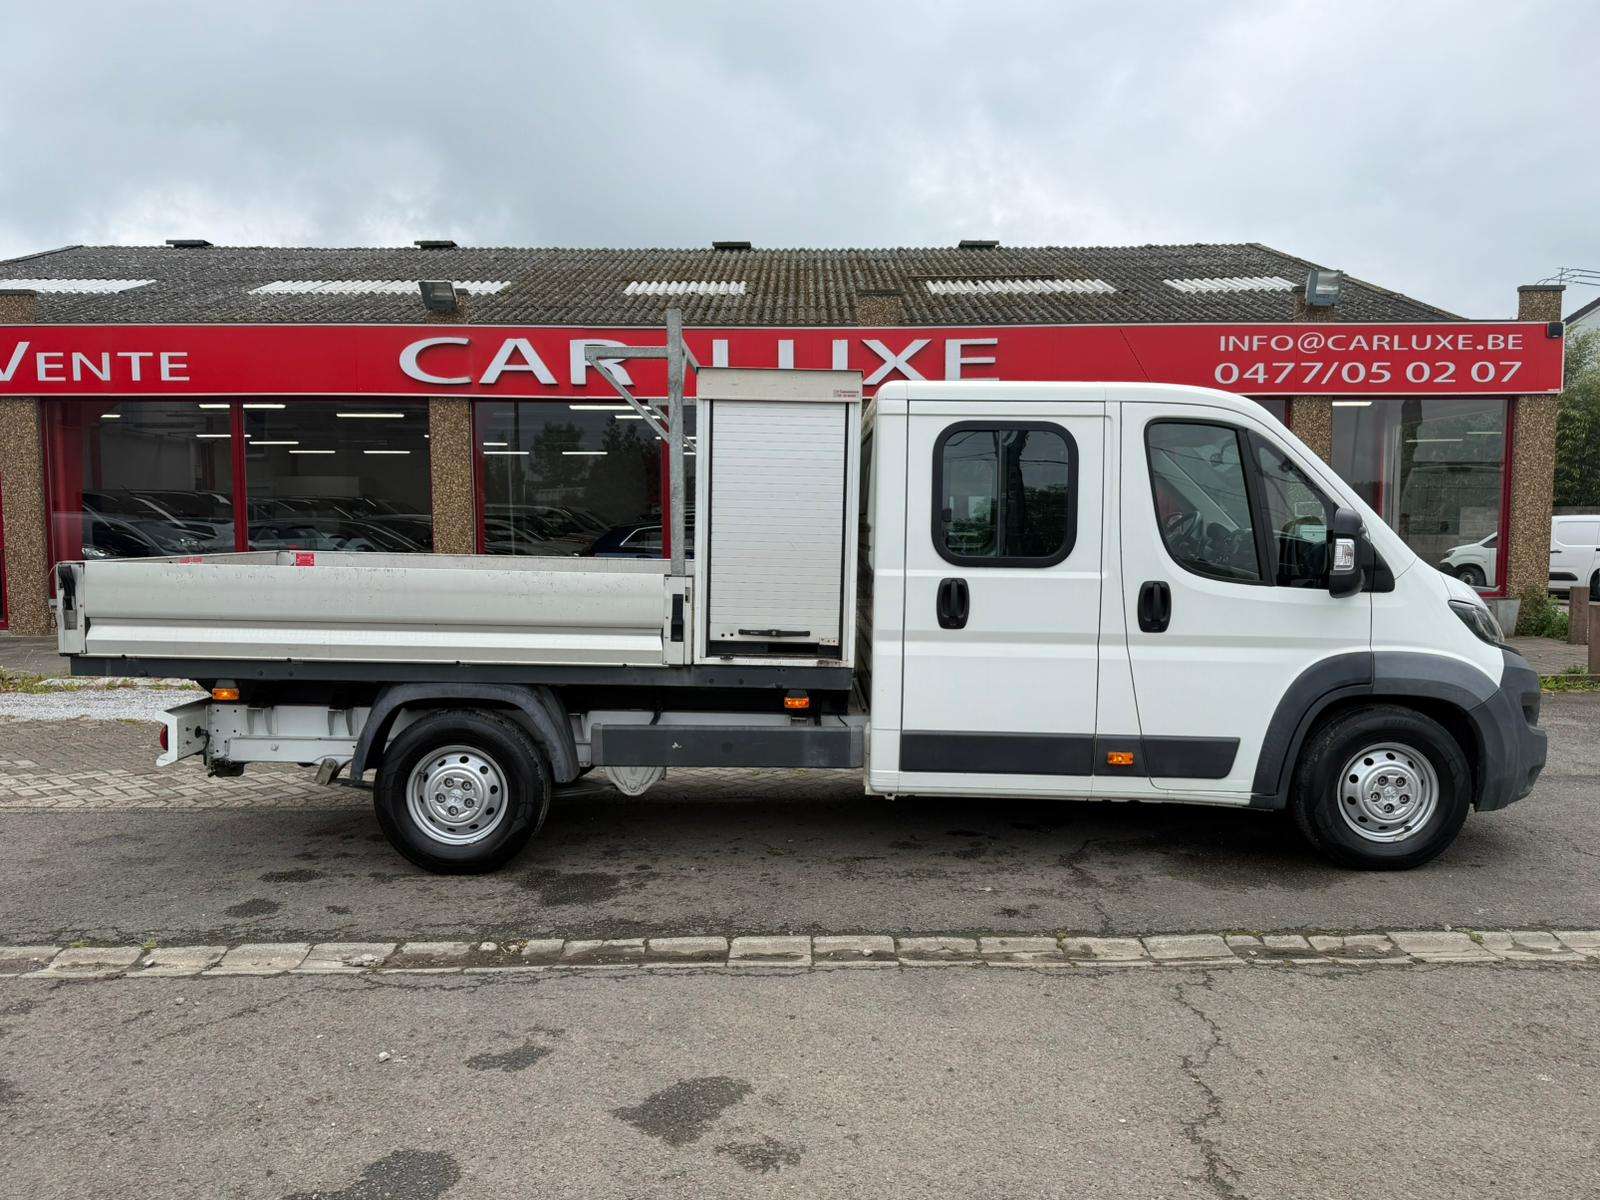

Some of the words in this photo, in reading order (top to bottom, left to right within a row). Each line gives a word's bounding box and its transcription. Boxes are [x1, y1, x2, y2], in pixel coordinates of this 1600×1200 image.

[1219, 332, 1524, 353] INFO@CARLUXE.BE
[399, 336, 635, 386] CAR
[1213, 361, 1391, 384] 0477/05
[1405, 361, 1456, 383] 02
[1470, 361, 1523, 383] 07
